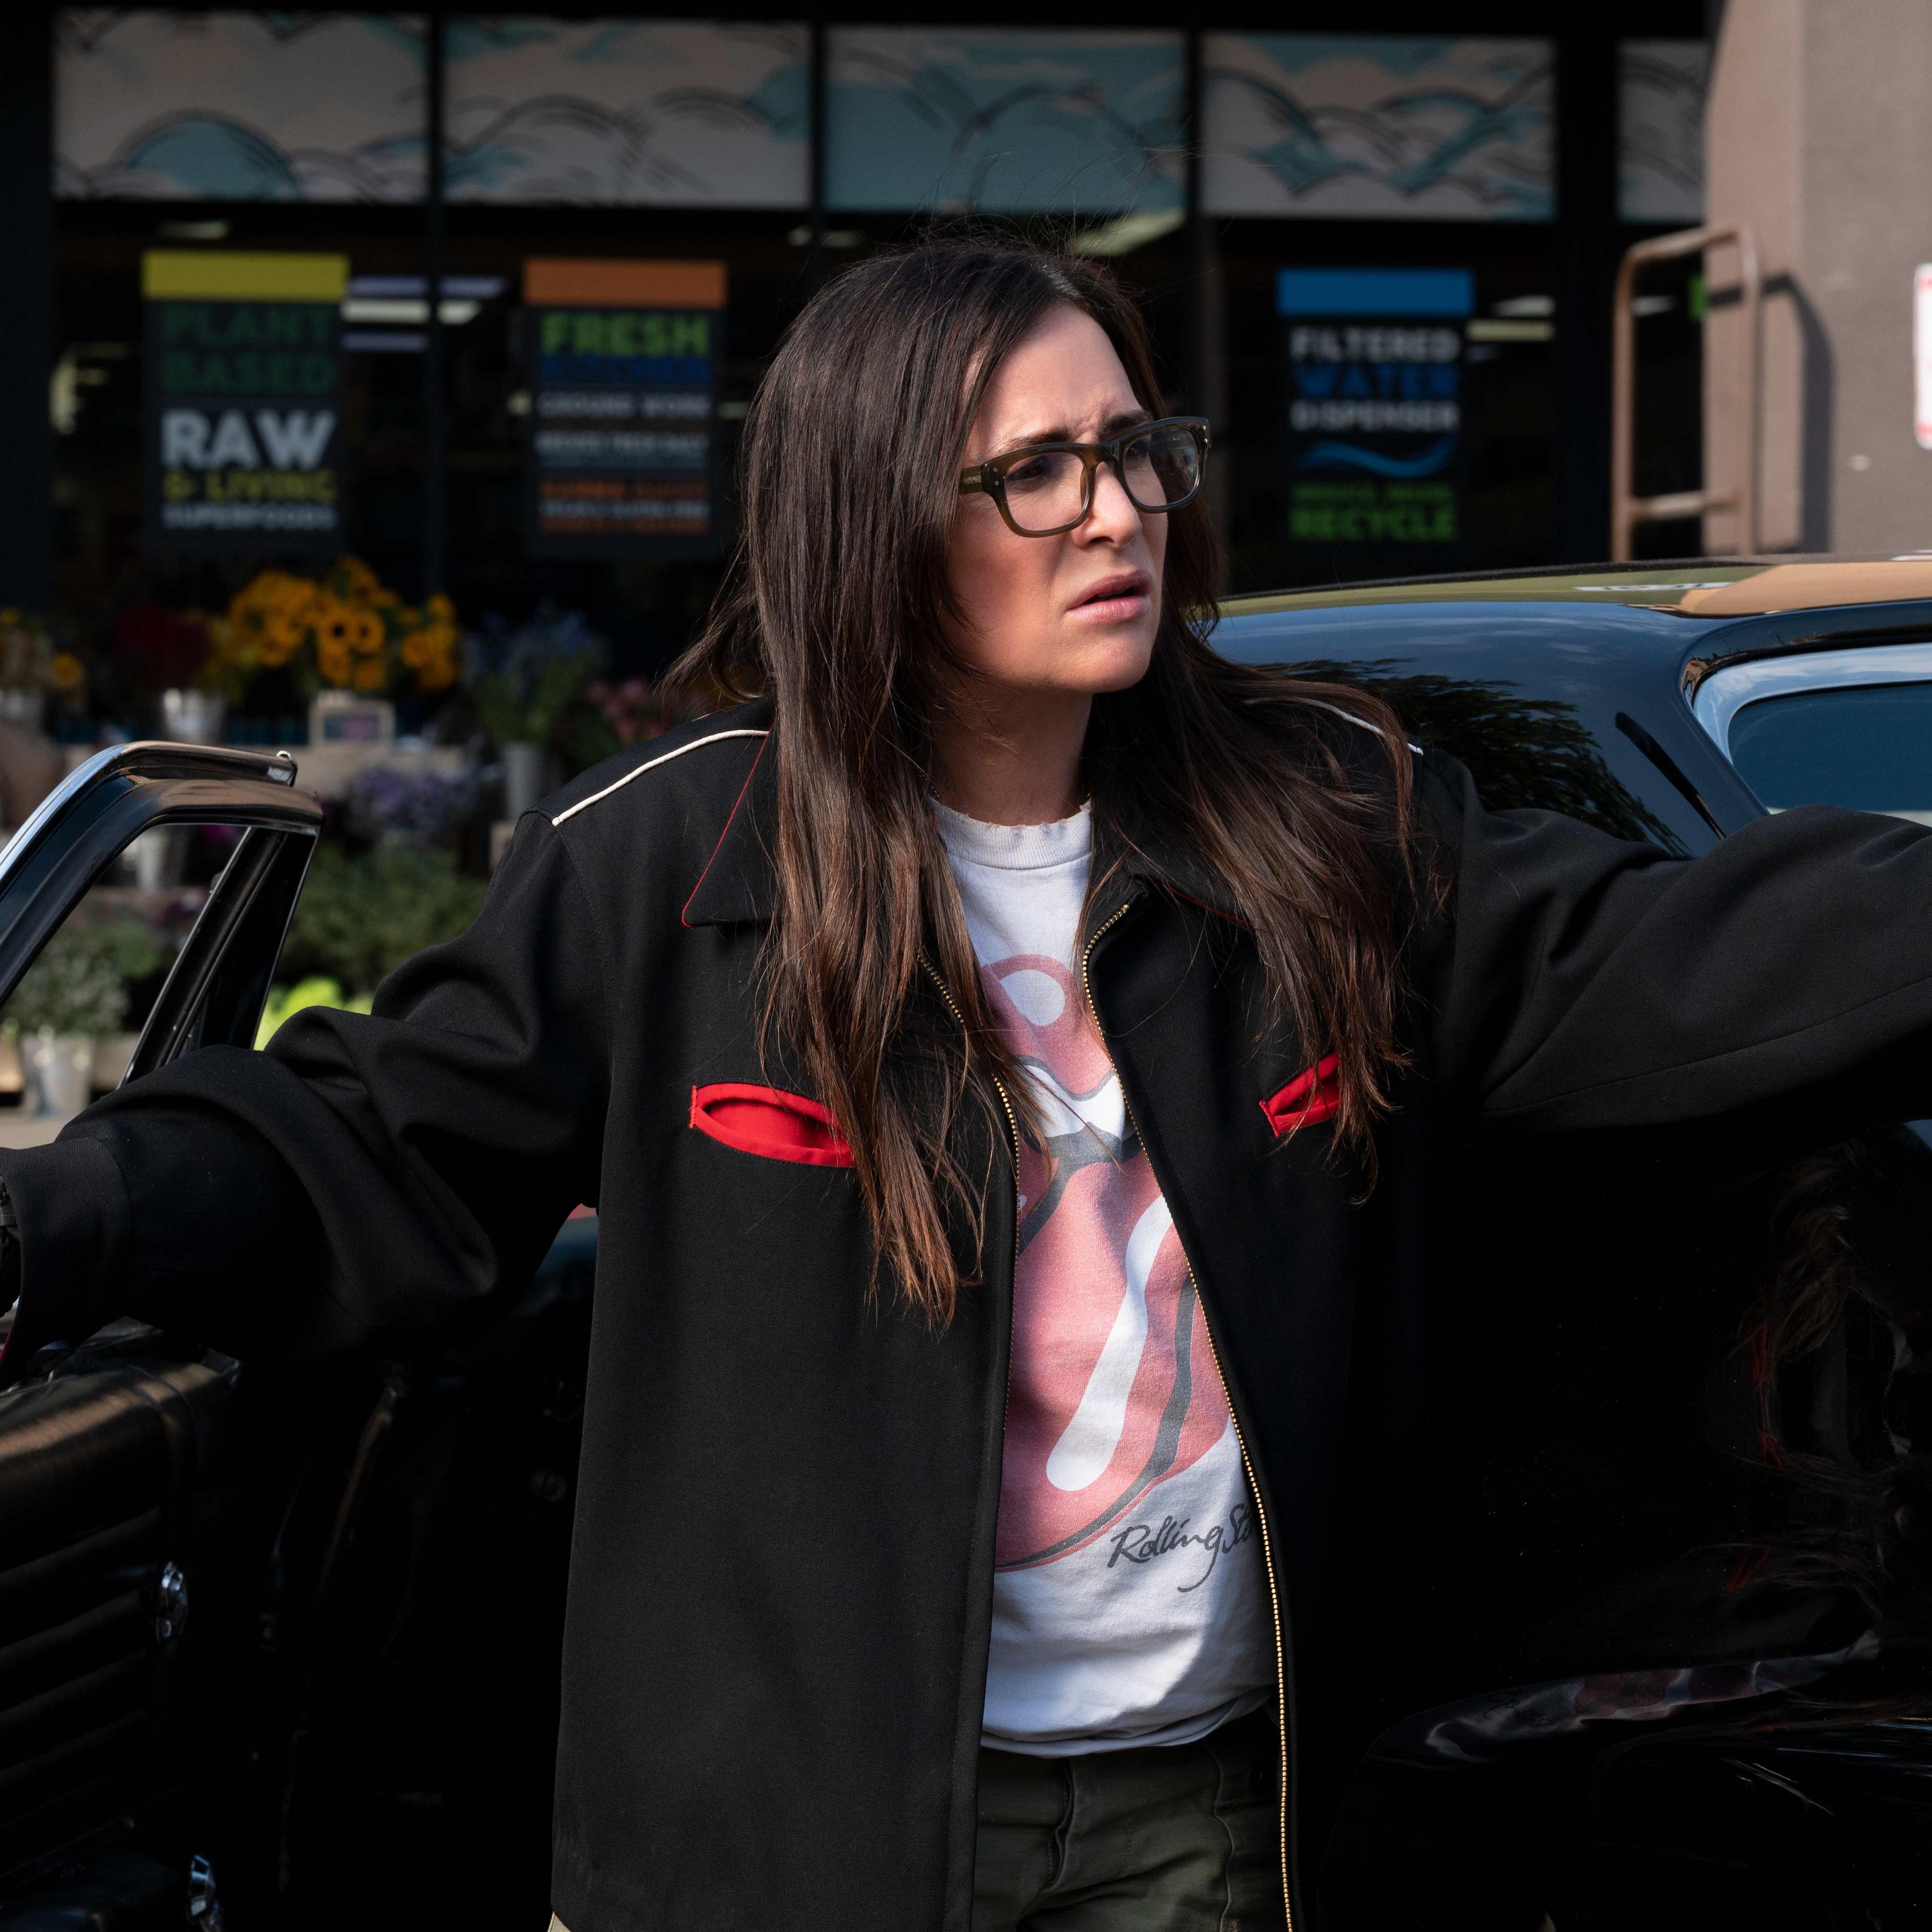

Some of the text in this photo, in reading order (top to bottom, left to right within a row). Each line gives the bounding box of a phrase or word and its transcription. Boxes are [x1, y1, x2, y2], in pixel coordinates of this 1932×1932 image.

[165, 303, 335, 346] PLANT
[540, 312, 709, 356] FRESH
[1291, 327, 1460, 363] FILTERED
[164, 352, 336, 393] BASED
[1293, 363, 1458, 398] WATER
[1291, 401, 1460, 432] DISPENSER
[160, 409, 337, 469] RAW
[164, 469, 338, 501] & LIVING
[162, 505, 338, 530] SUPERFOODS
[1291, 509, 1455, 541] RECYCLE
[1107, 1515, 1224, 1593] Rolling
